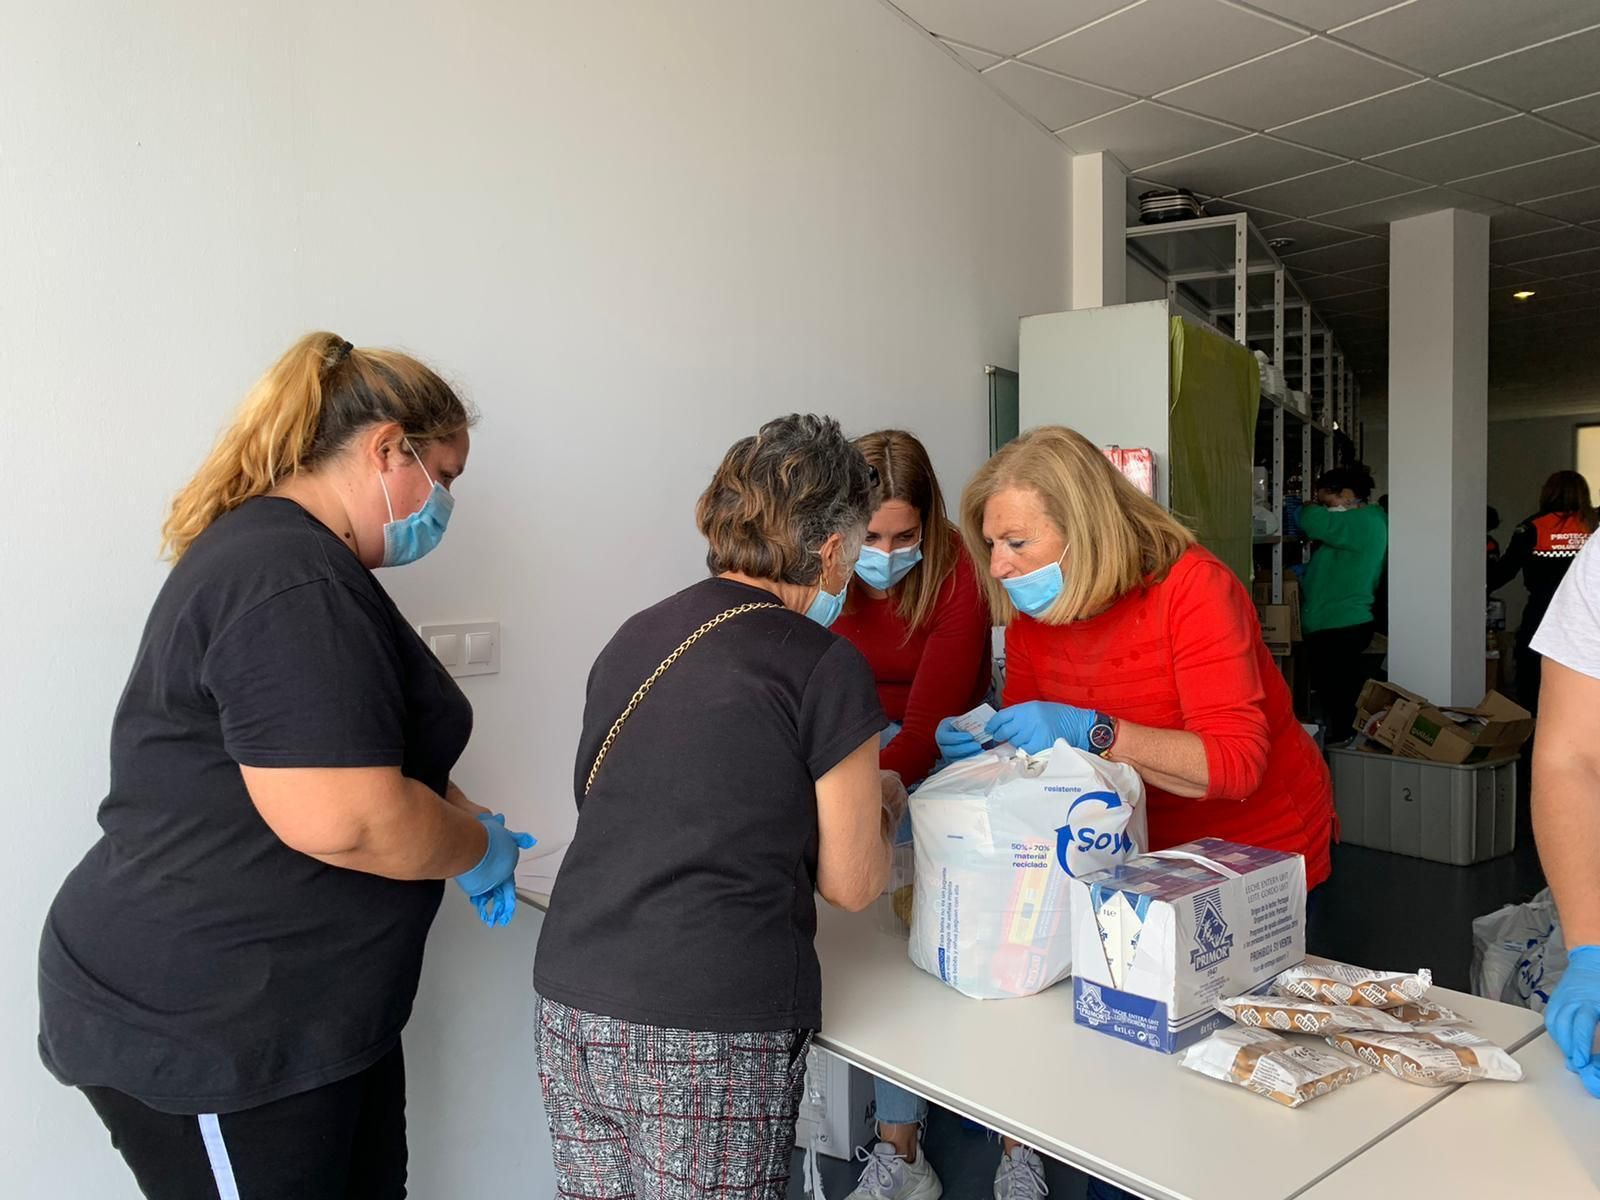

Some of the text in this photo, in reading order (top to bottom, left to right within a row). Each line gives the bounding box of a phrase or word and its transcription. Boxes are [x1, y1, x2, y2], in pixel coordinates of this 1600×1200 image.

[1044, 785, 1082, 793] resistente
[1402, 787, 1413, 802] 2
[1011, 843, 1028, 851] 50%
[1077, 827, 1121, 855] Soy
[1196, 946, 1229, 969] PRIMOR
[1301, 982, 1315, 997] SIN
[1371, 984, 1385, 996] SIN
